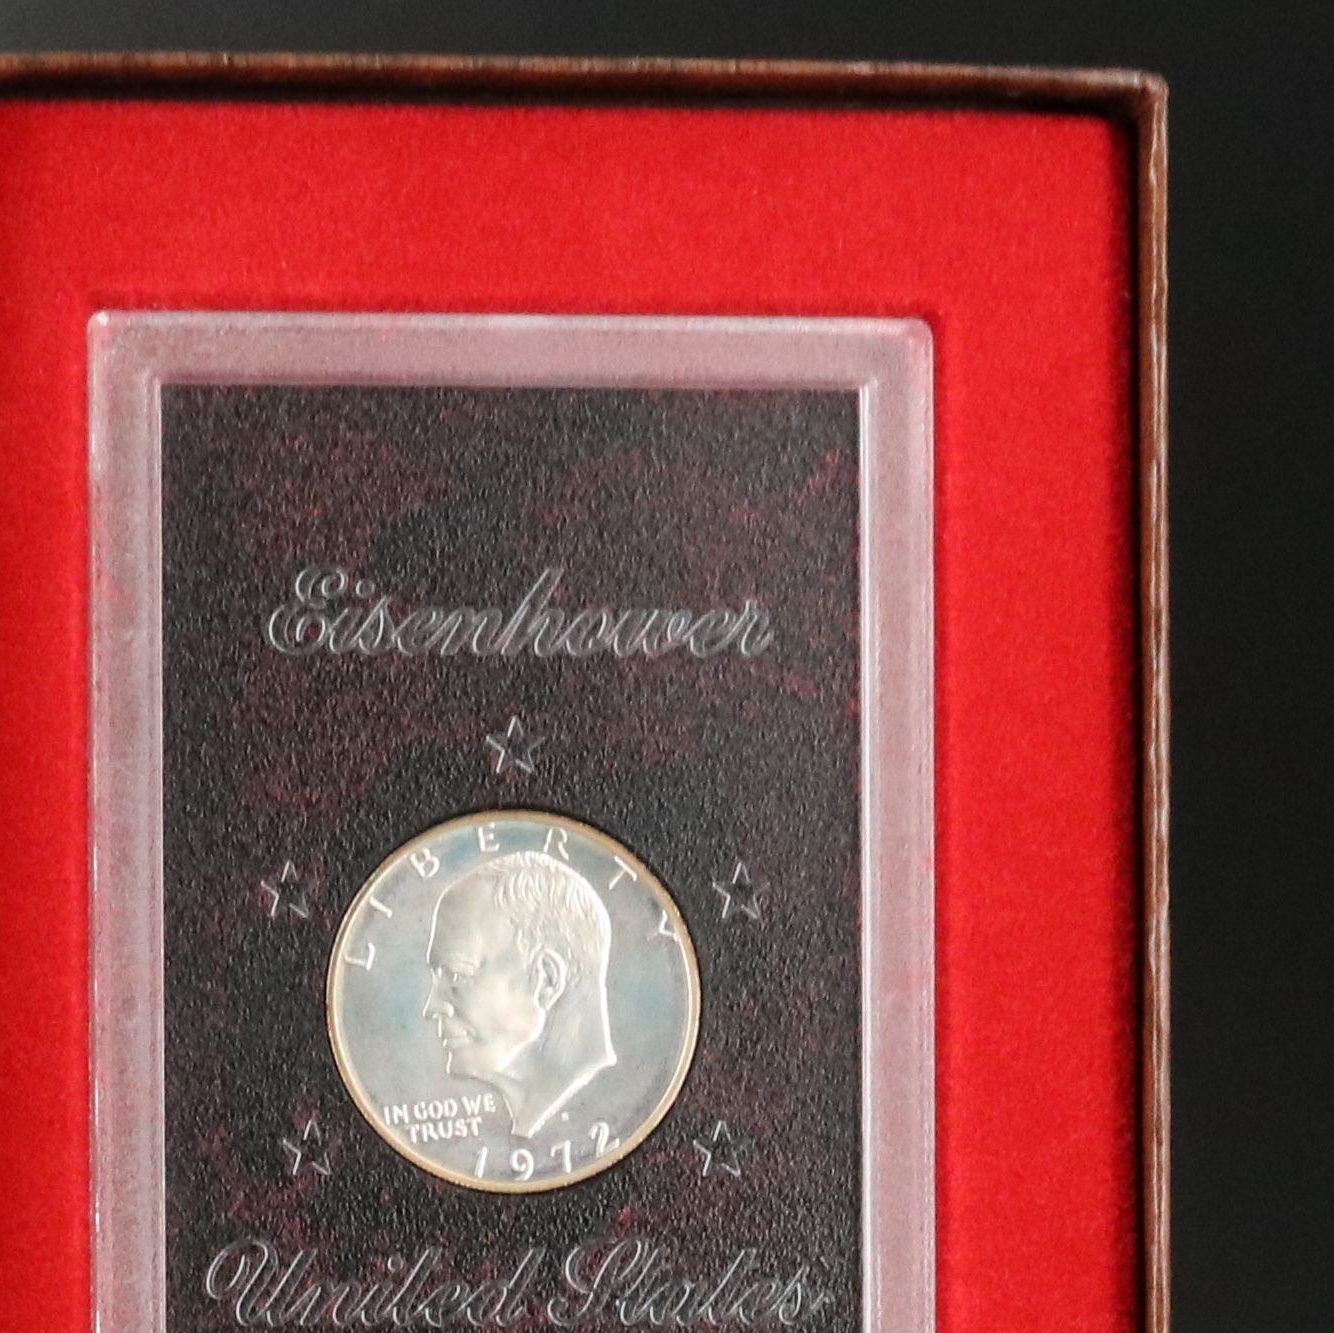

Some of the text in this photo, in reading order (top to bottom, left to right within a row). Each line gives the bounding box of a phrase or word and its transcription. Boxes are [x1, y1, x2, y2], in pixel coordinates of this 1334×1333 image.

[267, 564, 774, 657] Eisenhower
[345, 822, 681, 970] LIBERTY
[383, 1093, 497, 1126] IN GOD WE
[408, 1116, 483, 1144] TRUST
[474, 1121, 620, 1181] 1972
[206, 1237, 830, 1328] United States
